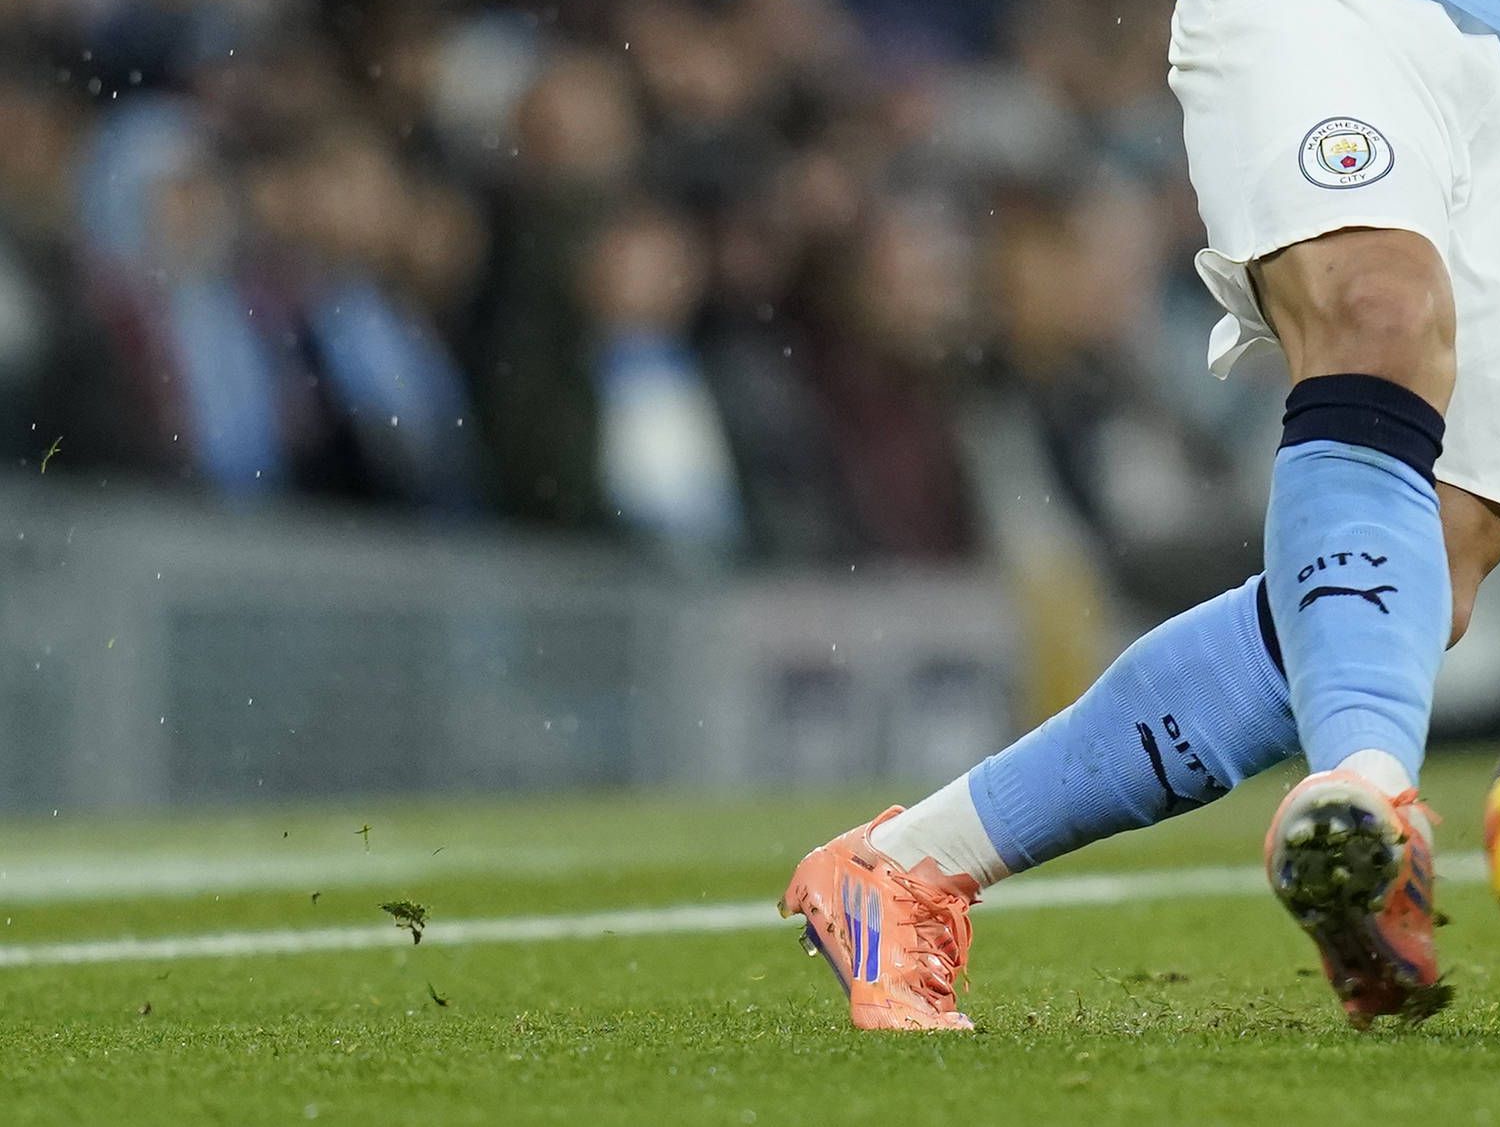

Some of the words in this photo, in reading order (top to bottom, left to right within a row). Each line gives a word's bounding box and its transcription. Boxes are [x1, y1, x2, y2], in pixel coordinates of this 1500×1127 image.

[1307, 121, 1381, 151] MANCHESTER
[1339, 173, 1367, 184] CITY
[1297, 552, 1388, 583] CITY
